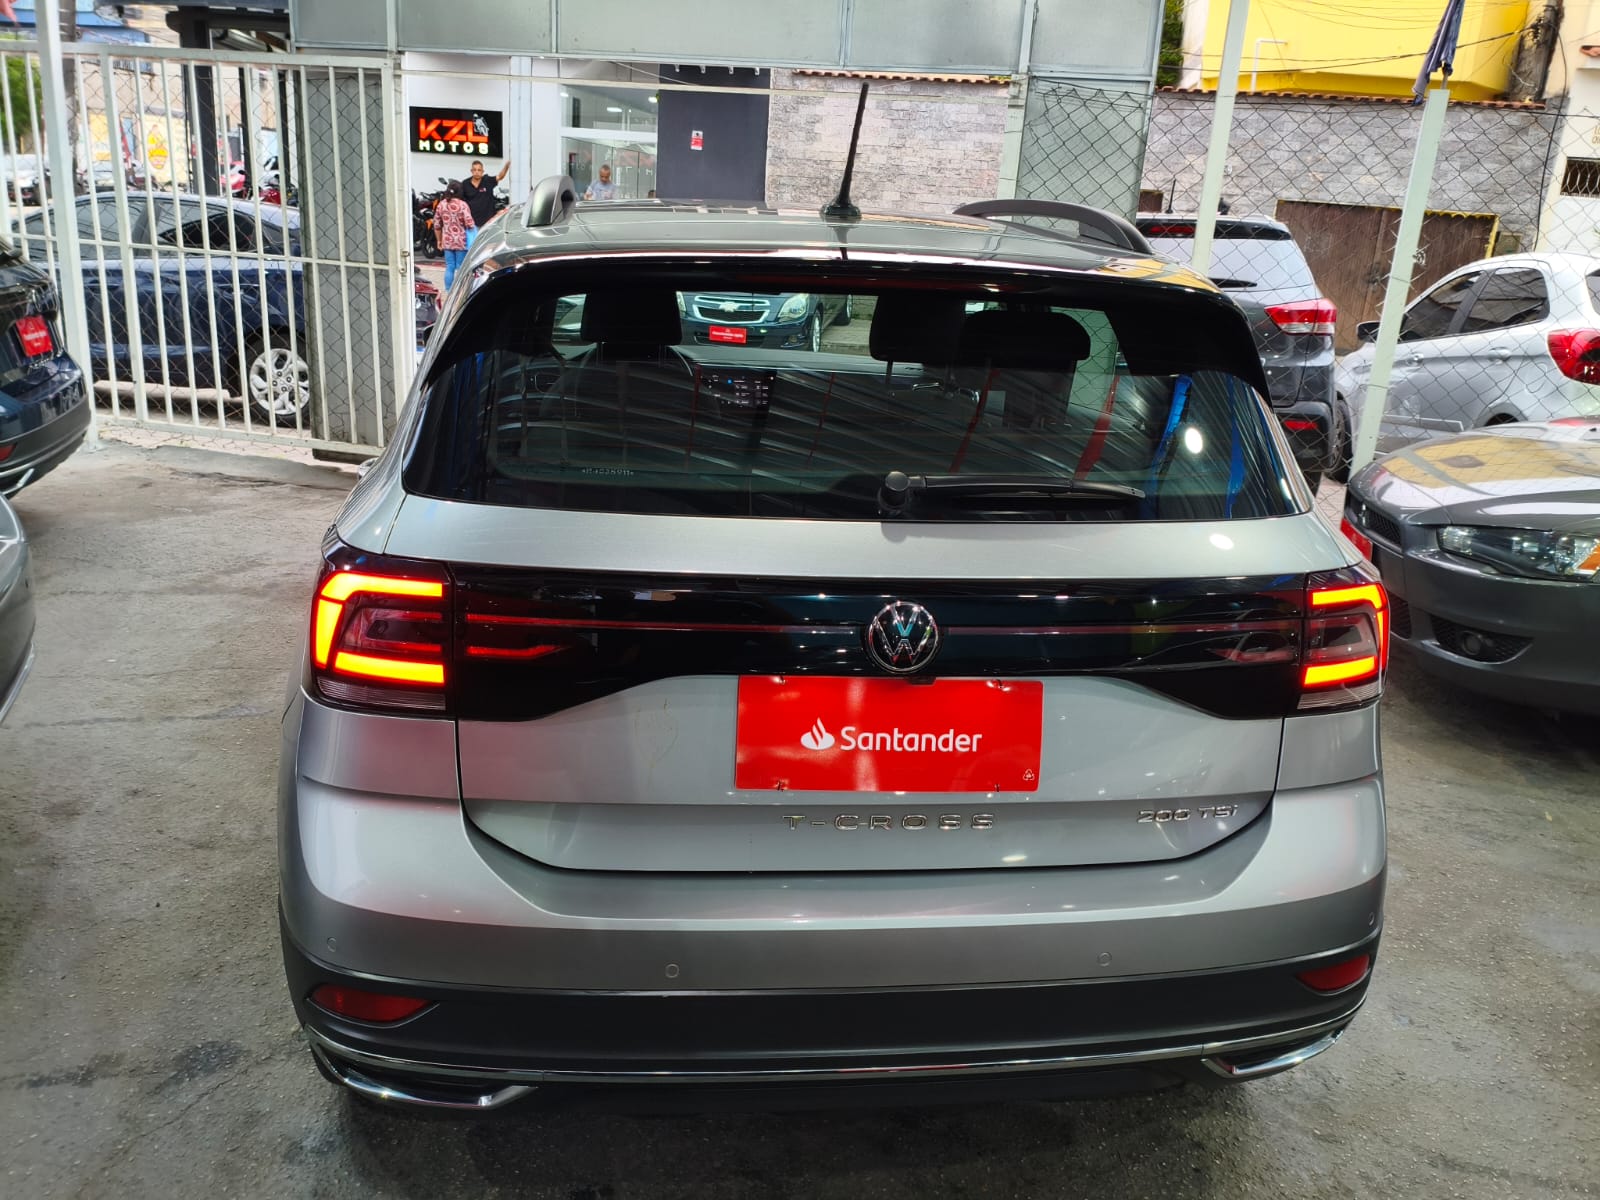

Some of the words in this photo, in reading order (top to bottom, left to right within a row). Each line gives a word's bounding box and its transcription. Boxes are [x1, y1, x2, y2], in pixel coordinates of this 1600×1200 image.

[419, 118, 488, 142] KZL
[419, 140, 489, 154] MOTOS
[841, 726, 982, 752] Santander
[783, 814, 994, 831] T-CROSS
[1137, 809, 1191, 823] 200
